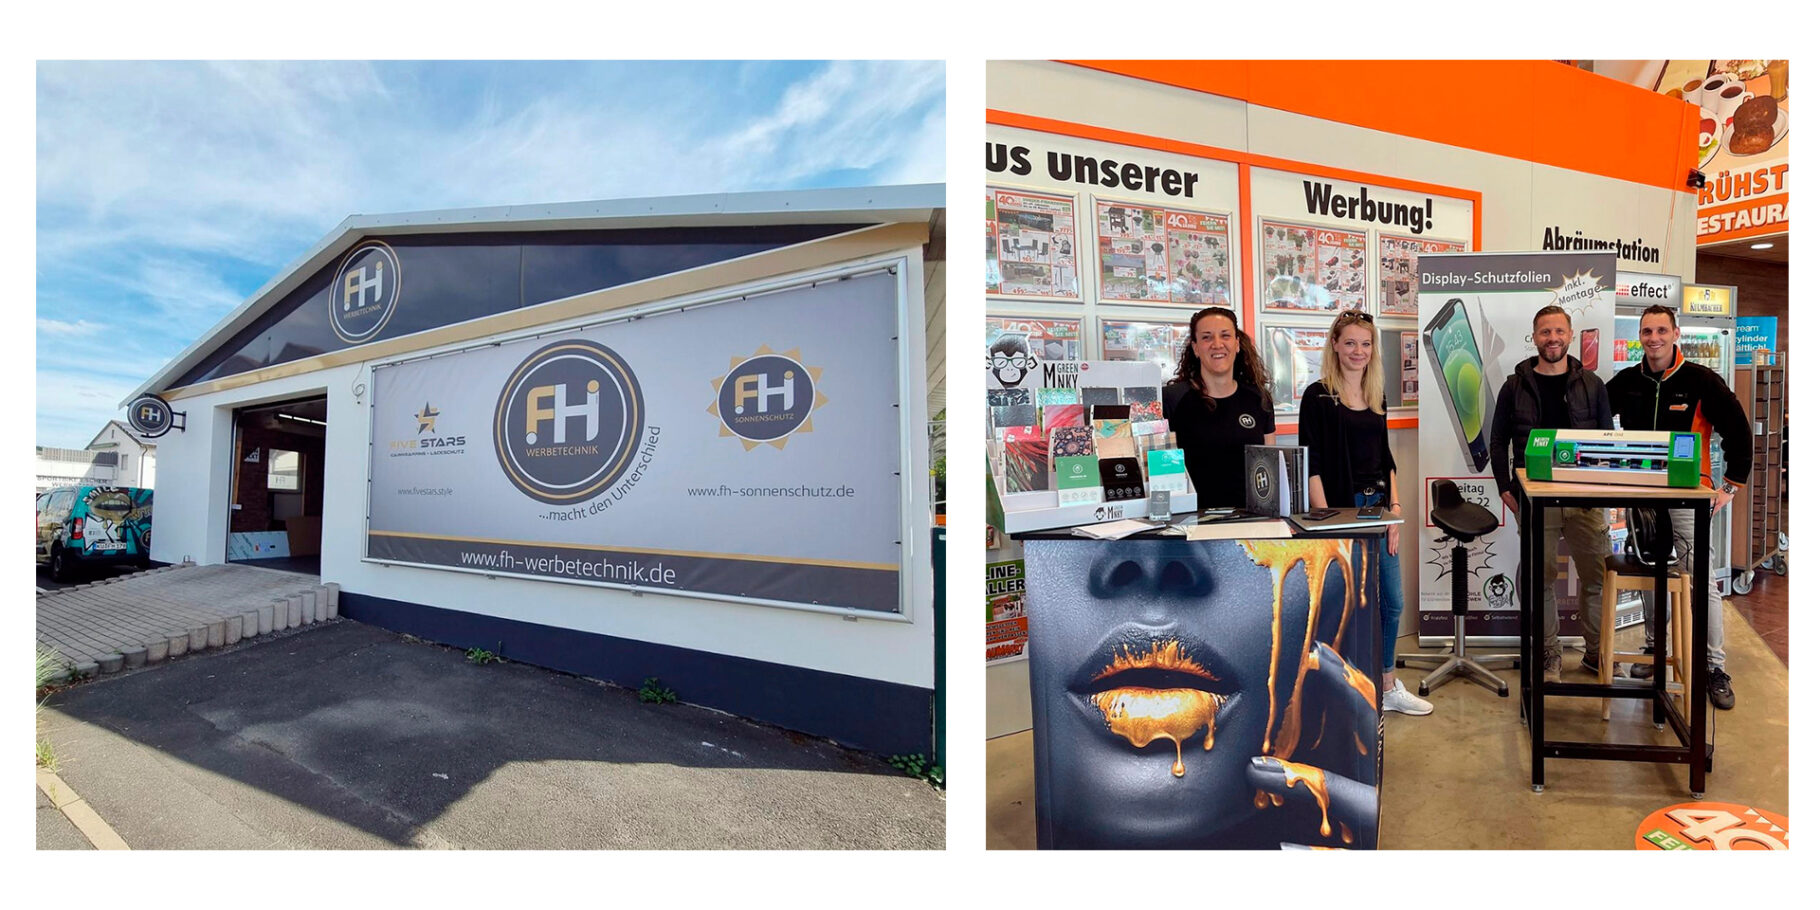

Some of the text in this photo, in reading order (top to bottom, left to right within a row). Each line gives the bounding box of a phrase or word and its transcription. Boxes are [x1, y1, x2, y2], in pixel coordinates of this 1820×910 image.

[1047, 151, 1199, 198] unserer
[1303, 180, 1433, 234] Werbung!
[1543, 226, 1659, 263] Abräumstation
[1422, 271, 1551, 287] Display-Schutzfolien
[1564, 276, 1586, 292] inkl.
[1557, 284, 1601, 306] Montage
[1057, 363, 1079, 374] GREEN
[734, 413, 795, 424] SONNENSCHUTZ
[420, 436, 466, 449] STARS
[525, 445, 599, 458] WERBETECHNIK
[589, 497, 613, 516] den
[611, 425, 662, 502] Unterschied
[687, 484, 855, 498] www.fh-sonnenschutz.de
[461, 550, 676, 585] www.fh-werbetechnik.de
